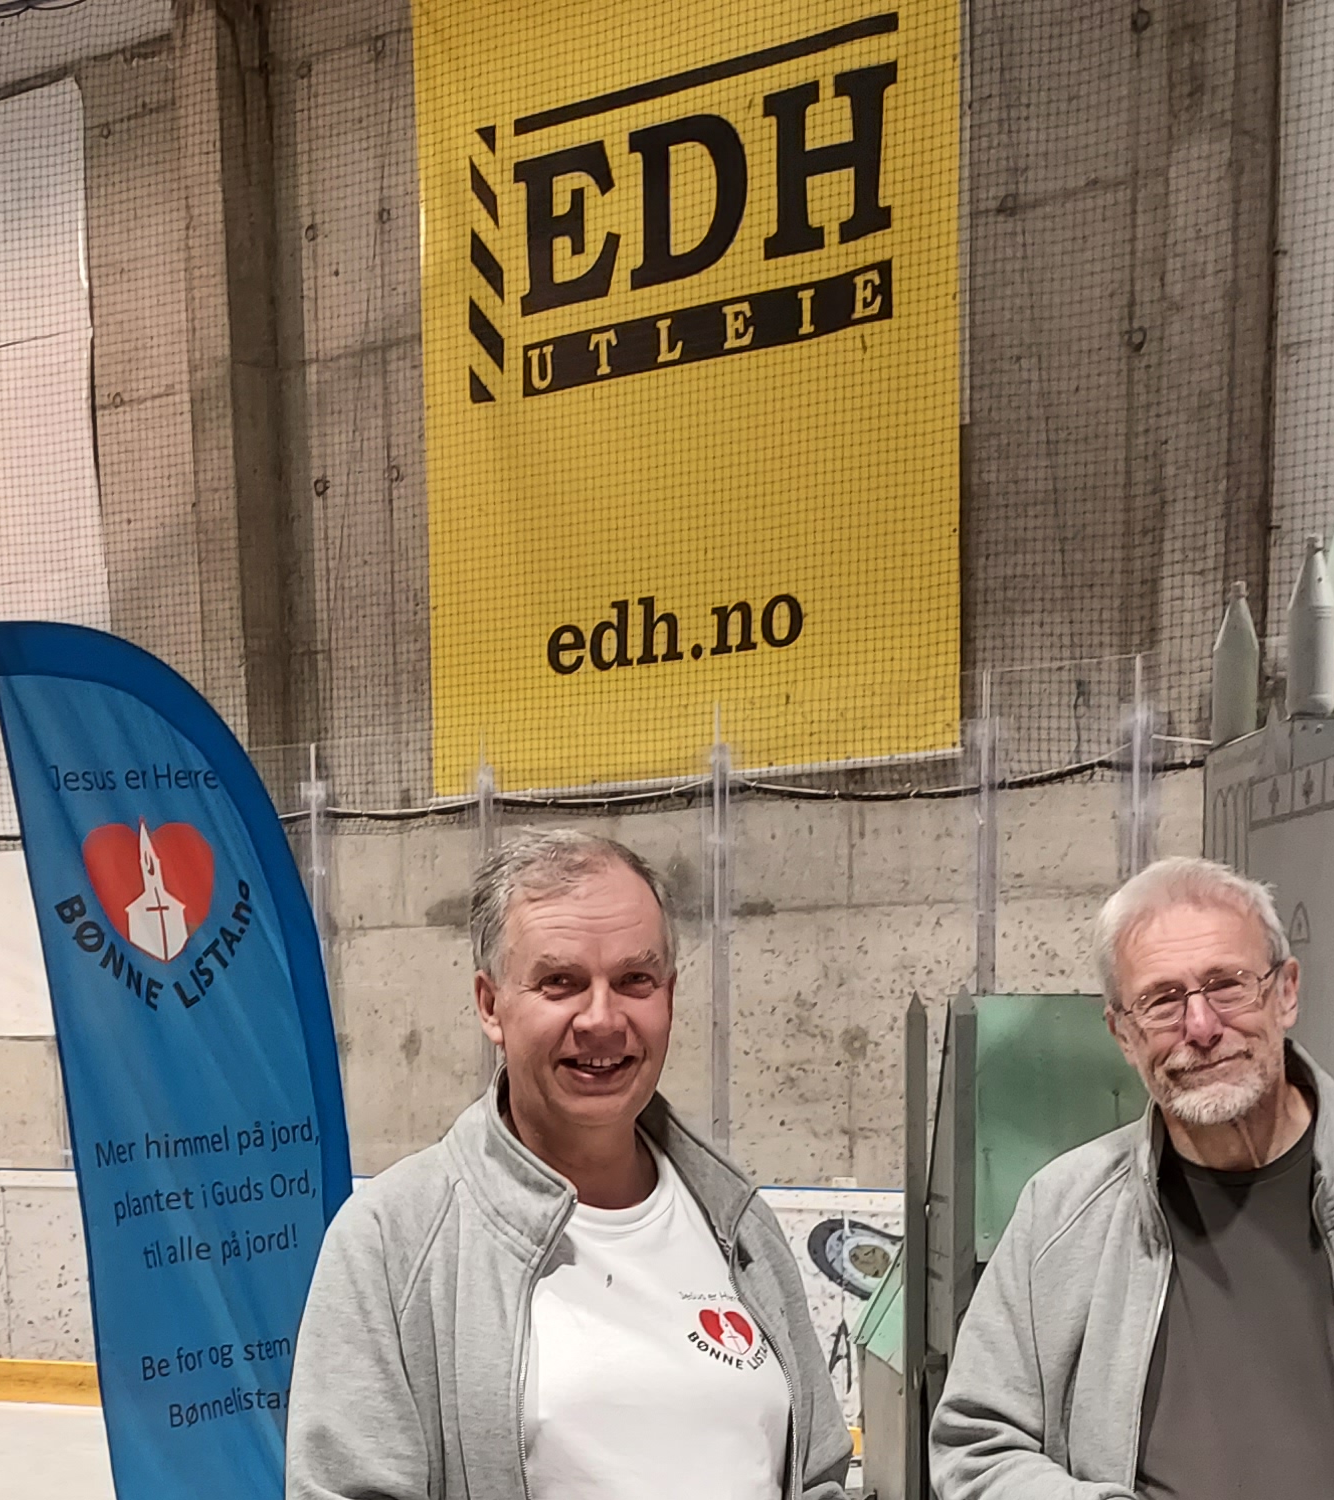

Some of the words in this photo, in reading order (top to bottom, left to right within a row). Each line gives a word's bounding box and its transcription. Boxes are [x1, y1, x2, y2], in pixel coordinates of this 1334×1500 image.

[514, 60, 899, 317] EDH
[526, 269, 885, 390] UTLEIE
[546, 592, 805, 675] edh.no
[49, 765, 117, 792] Jesus
[124, 768, 148, 790] er
[152, 763, 220, 791] Herre
[54, 894, 164, 1011] BØNNE
[172, 879, 254, 1010] LISTA.no
[95, 1141, 137, 1168] Mer
[145, 1125, 230, 1159] himmel
[237, 1121, 265, 1156] på
[269, 1116, 320, 1152] jord,
[113, 1187, 194, 1227] plantet
[211, 1175, 264, 1205] Guds
[270, 1168, 317, 1200] Ord,
[143, 1242, 164, 1269] til
[168, 1235, 212, 1264] alle
[221, 1231, 243, 1266] på
[245, 1223, 299, 1263] jord!
[141, 1355, 171, 1382] Be
[175, 1346, 203, 1374] for
[208, 1343, 235, 1368] og
[243, 1337, 292, 1361] stem
[687, 1331, 744, 1370] BØNNE
[169, 1387, 290, 1429] Bønnelista.
